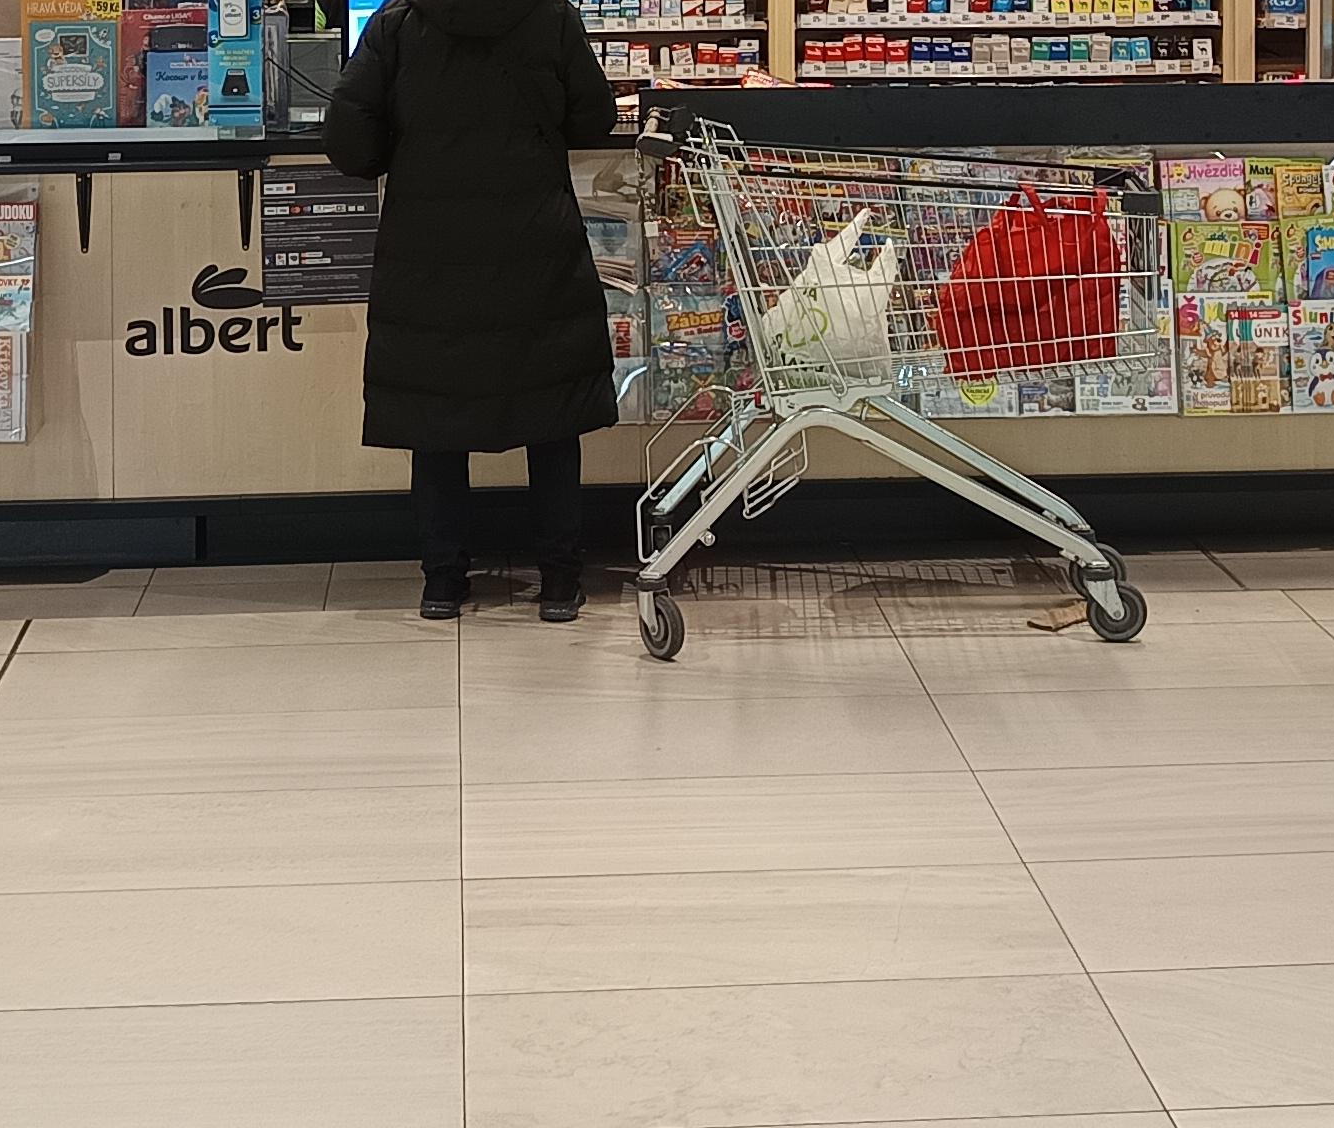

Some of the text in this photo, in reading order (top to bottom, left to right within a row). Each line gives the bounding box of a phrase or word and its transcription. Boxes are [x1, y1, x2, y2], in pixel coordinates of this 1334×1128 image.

[27, 1, 57, 14] HRAVÁ
[96, 2, 108, 12] 59
[125, 306, 304, 356] albert
